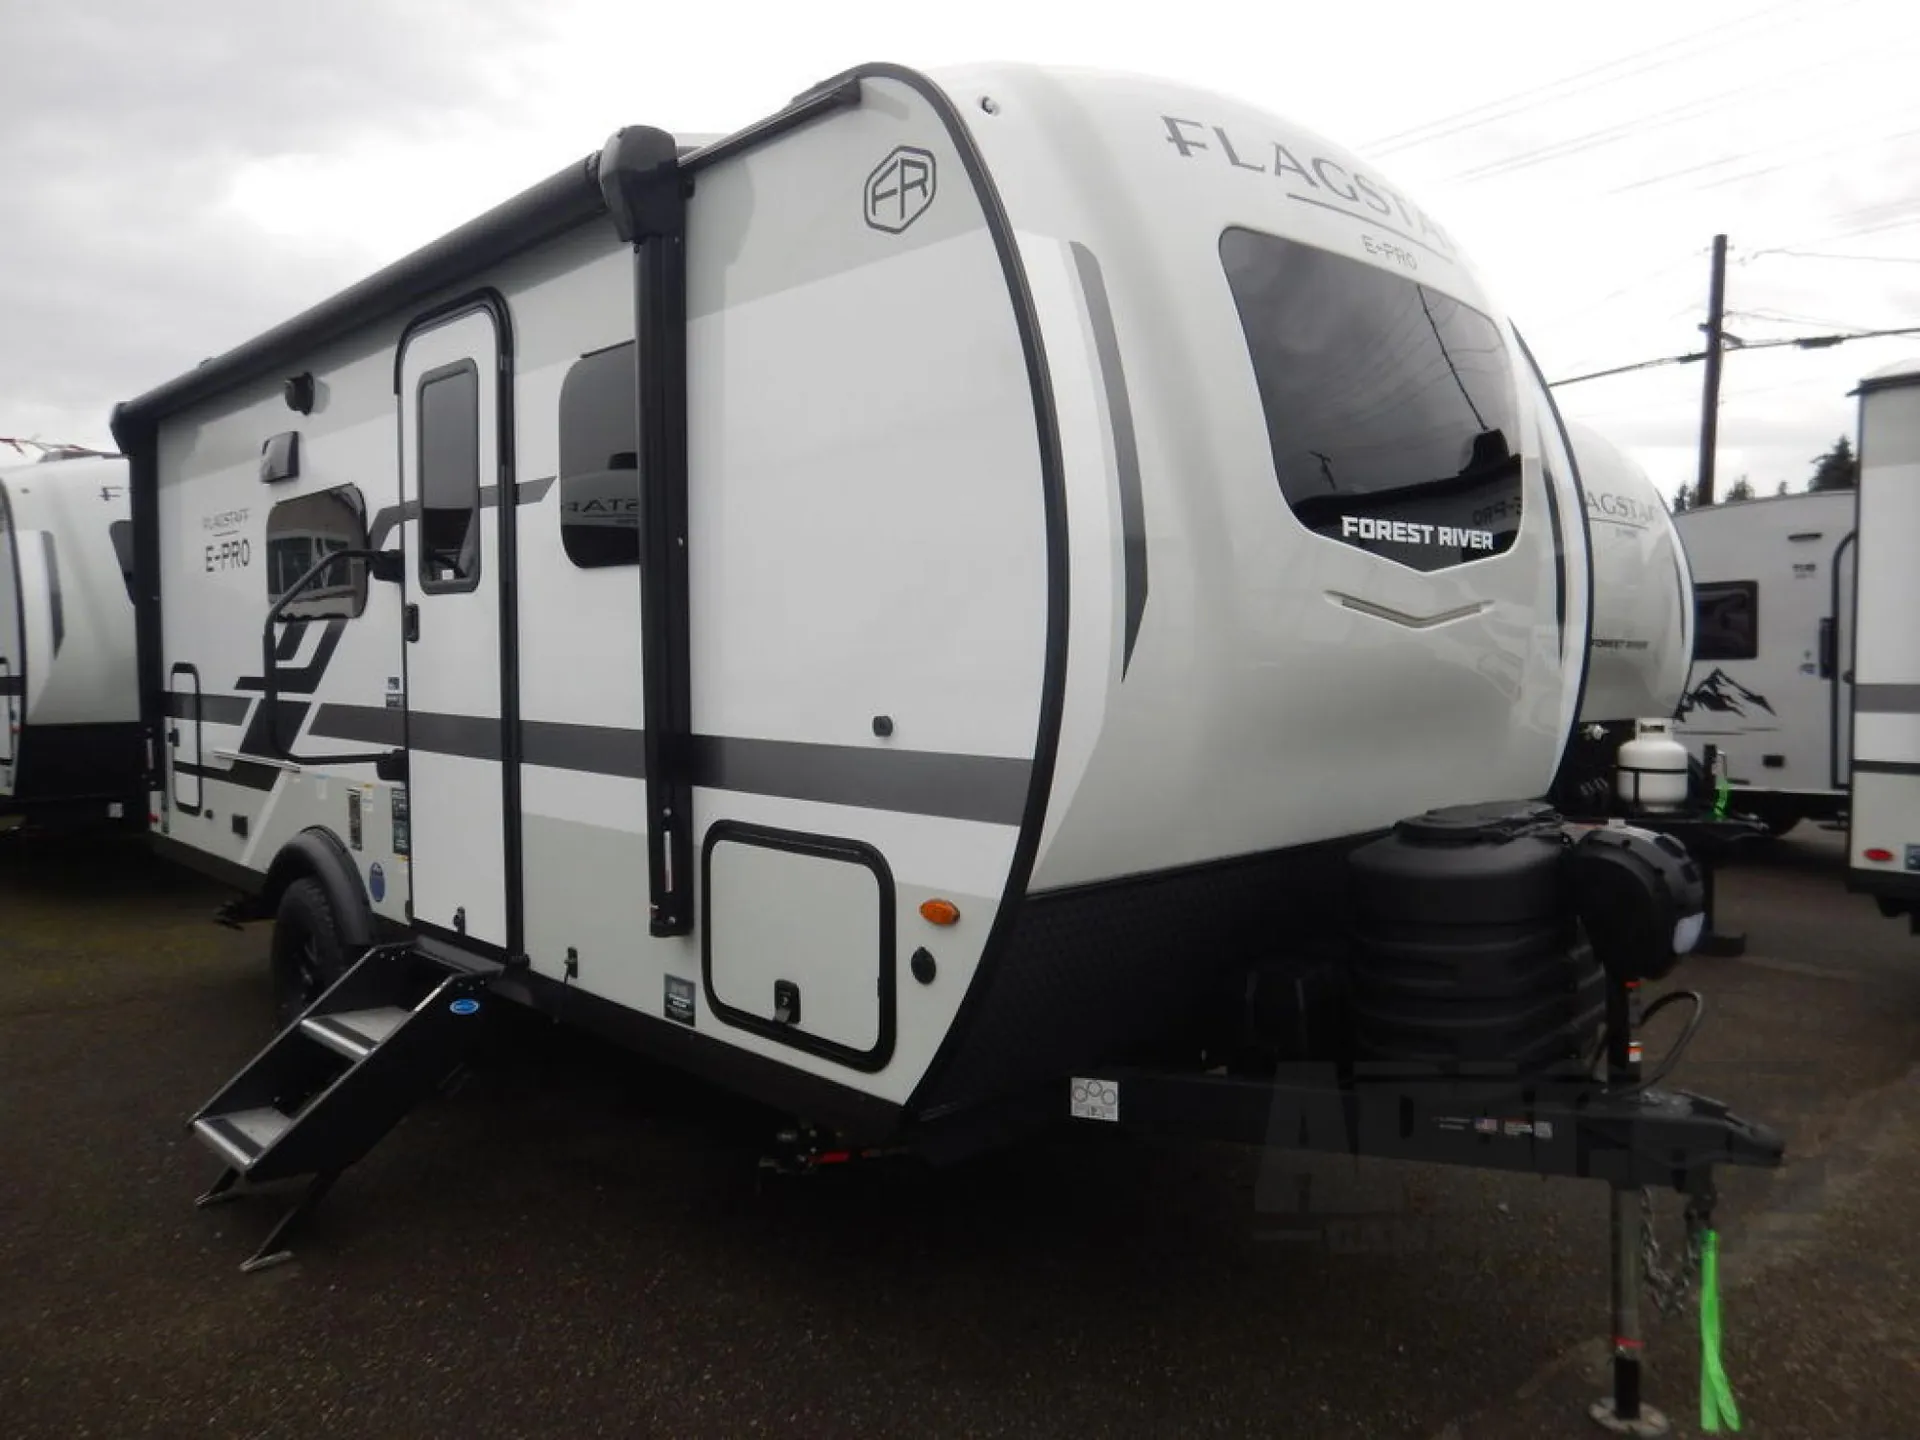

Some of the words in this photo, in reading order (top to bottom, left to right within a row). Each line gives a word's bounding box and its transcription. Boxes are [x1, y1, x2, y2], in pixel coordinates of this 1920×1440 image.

[1160, 115, 1457, 254] FLAGSTA
[1361, 234, 1418, 270] E-PRO
[1341, 515, 1435, 545] FOREST
[1437, 526, 1494, 550] RIVER
[205, 539, 251, 573] E-PRO
